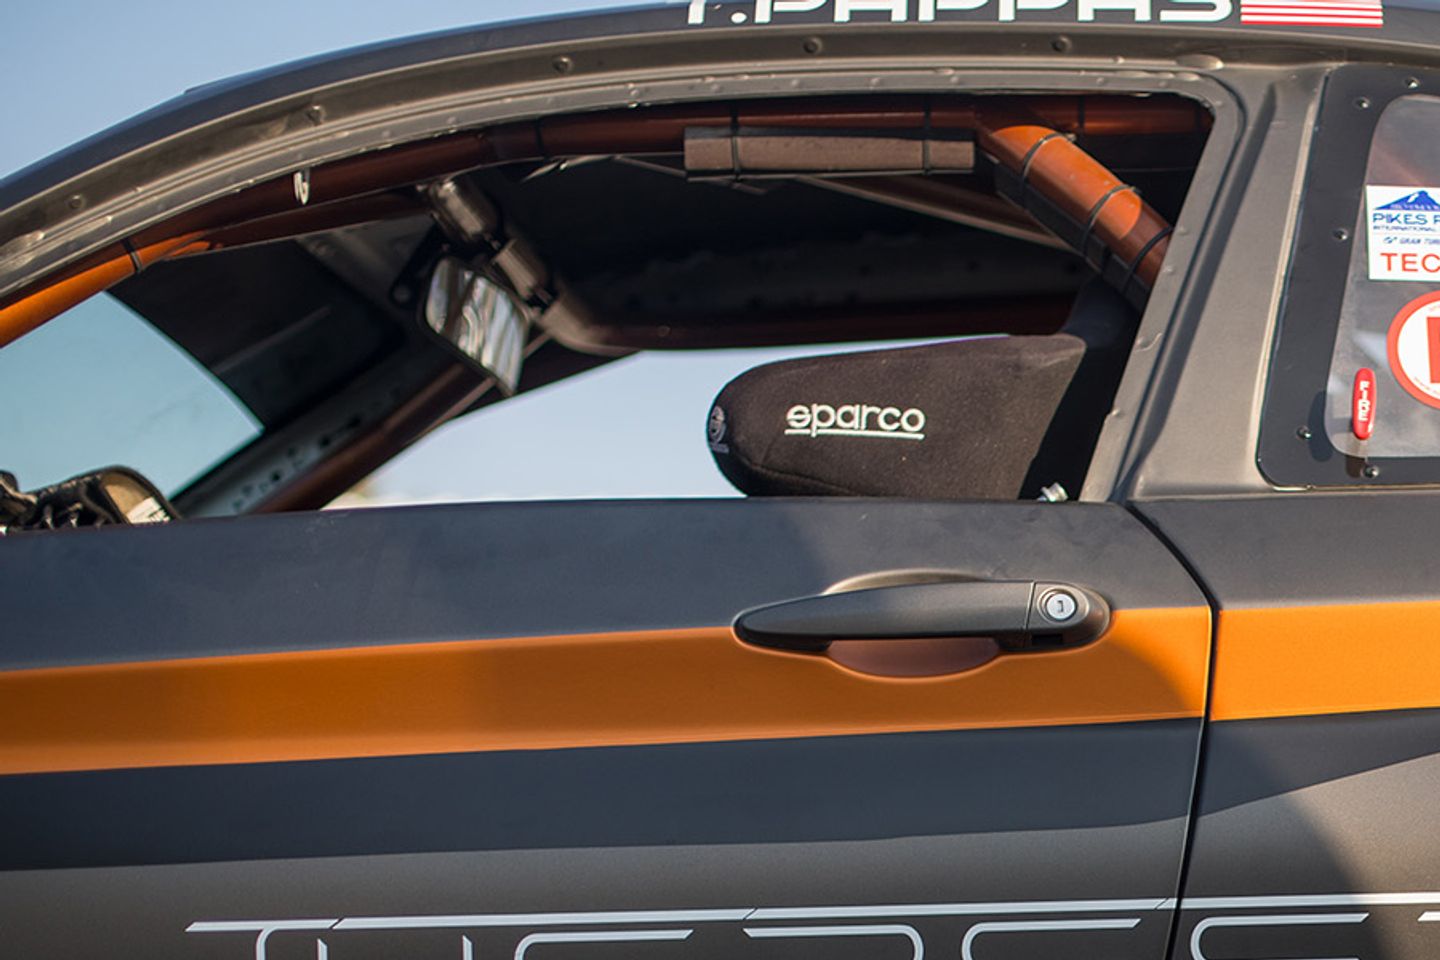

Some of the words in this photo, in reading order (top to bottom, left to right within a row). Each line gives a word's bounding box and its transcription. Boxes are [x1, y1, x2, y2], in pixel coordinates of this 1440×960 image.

[1372, 212, 1428, 225] PIKES
[1357, 380, 1371, 421] FIRE
[784, 403, 926, 440] sparco
